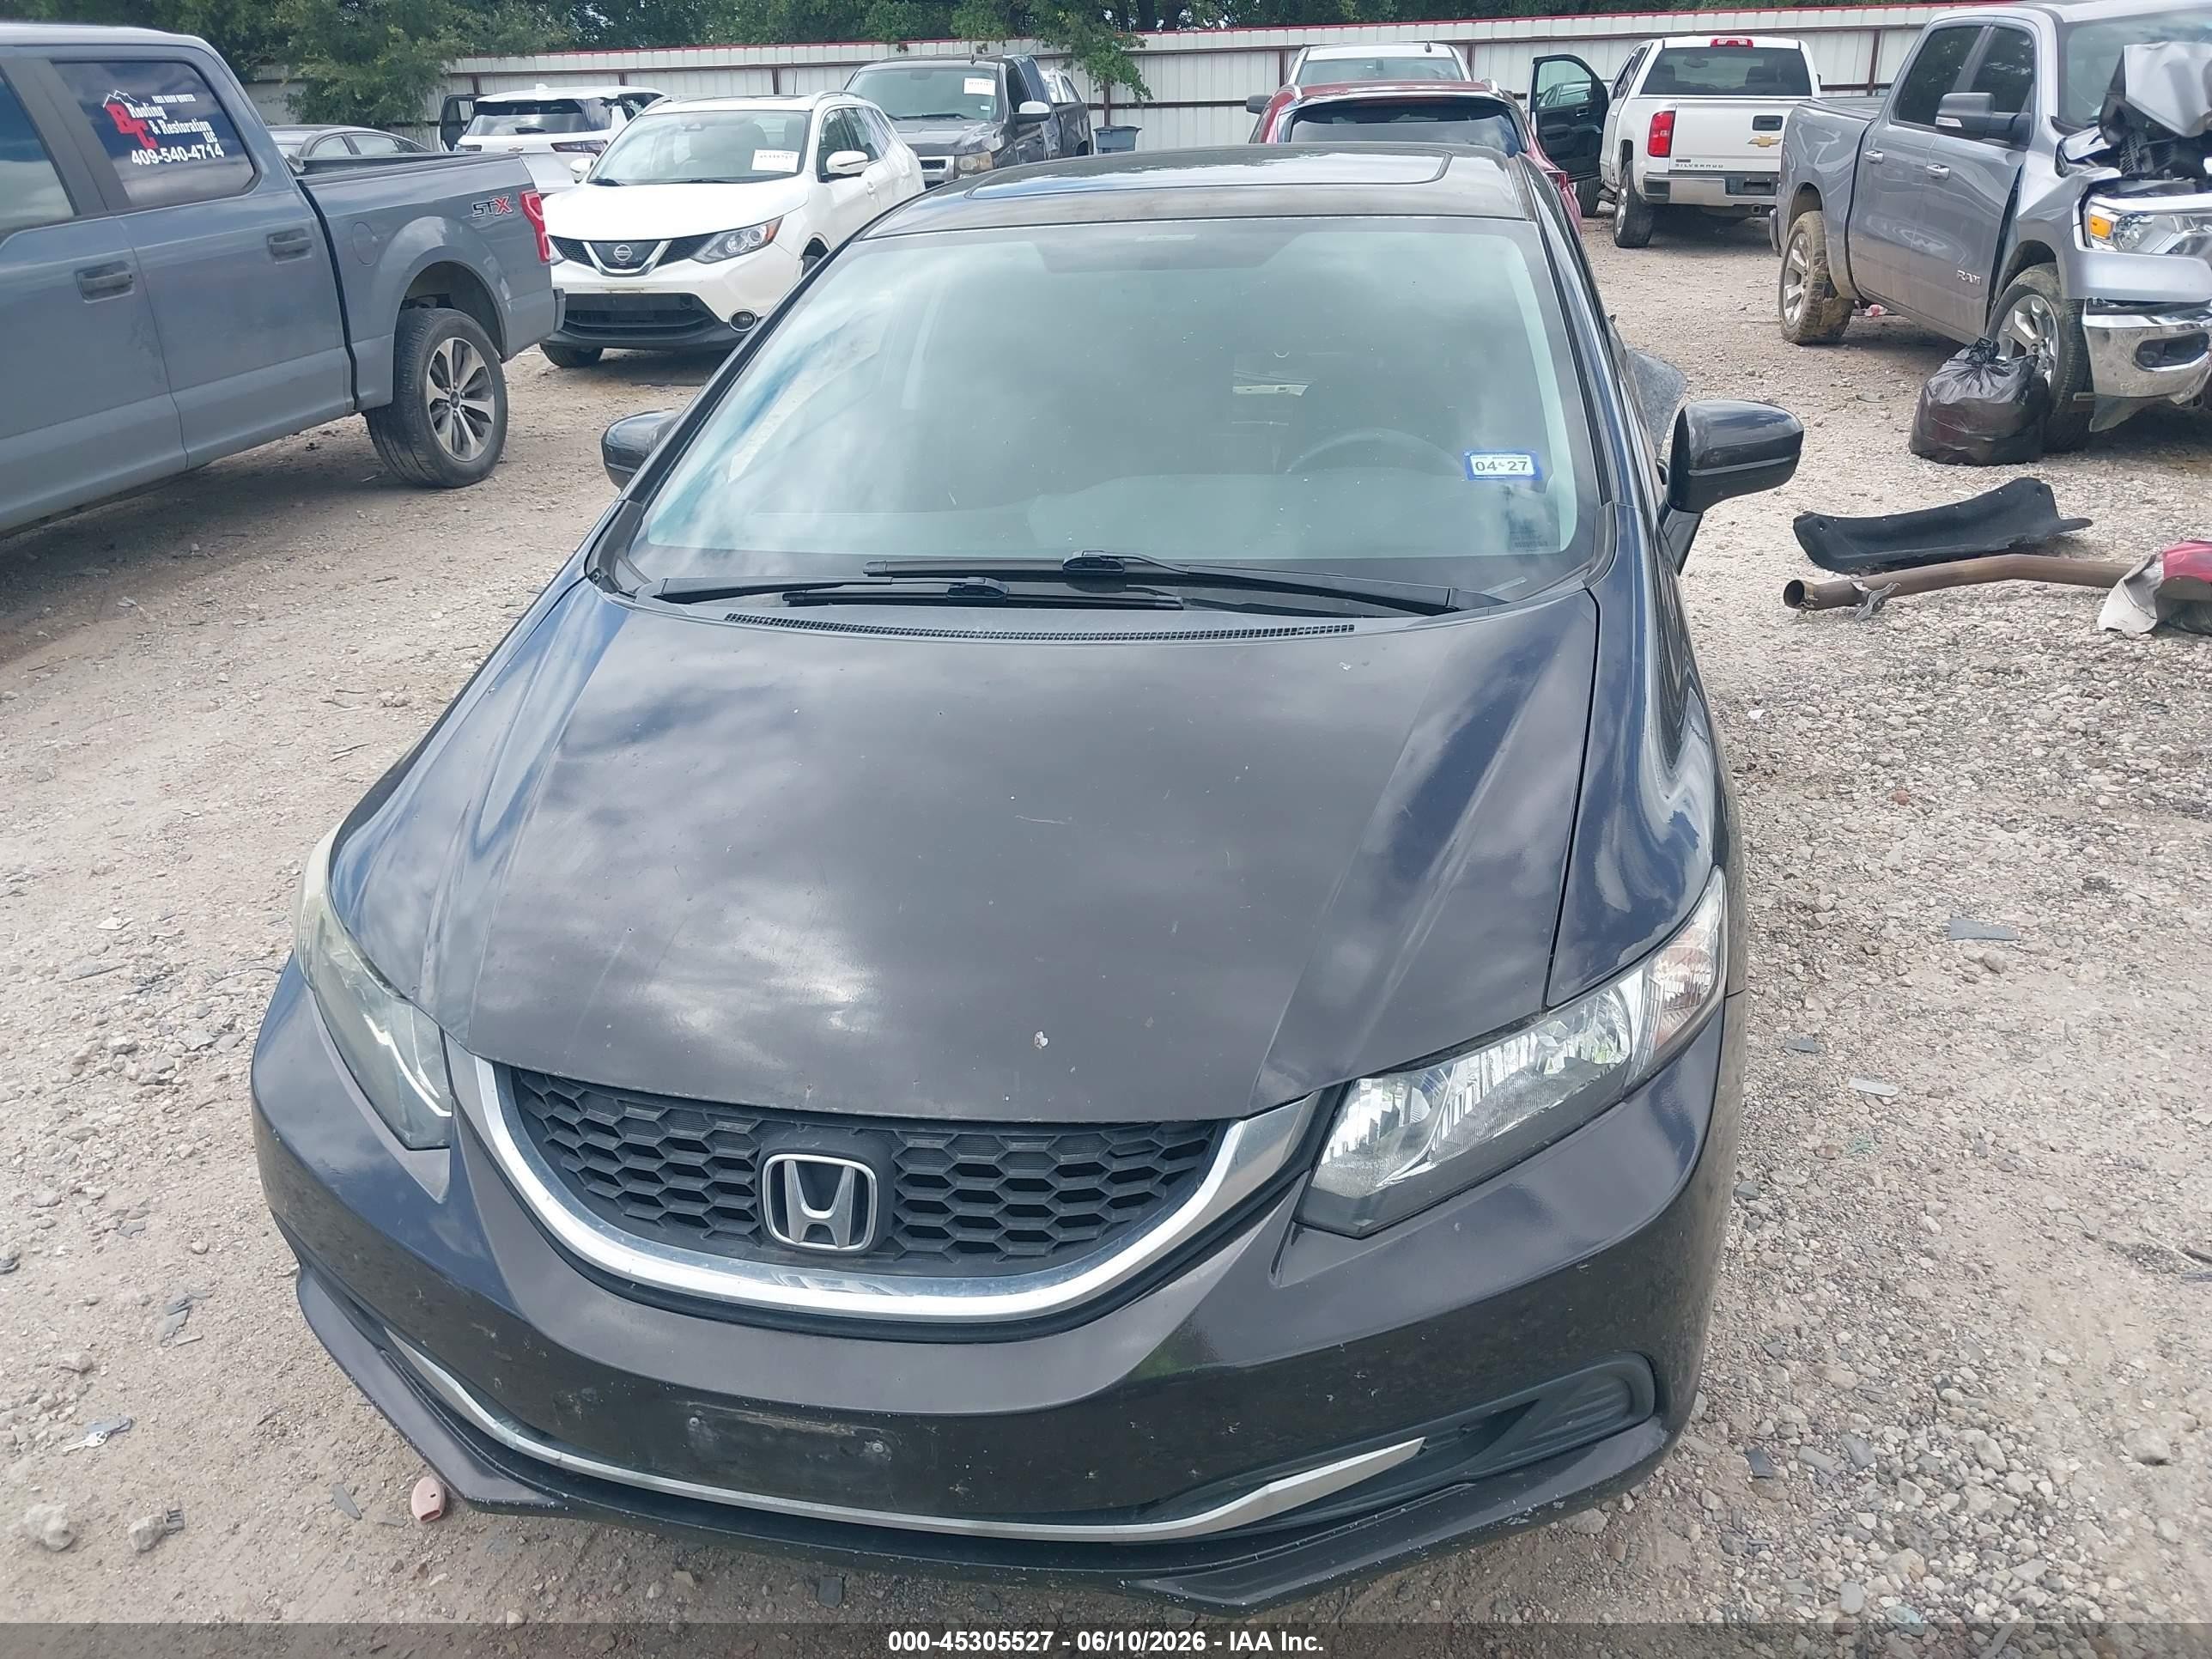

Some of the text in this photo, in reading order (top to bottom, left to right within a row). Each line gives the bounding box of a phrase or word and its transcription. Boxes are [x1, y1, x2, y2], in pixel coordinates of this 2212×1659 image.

[125, 102, 168, 120] Roofing
[157, 118, 213, 135] Restoration
[131, 143, 225, 166] 409-540-4714
[473, 196, 513, 217] STX
